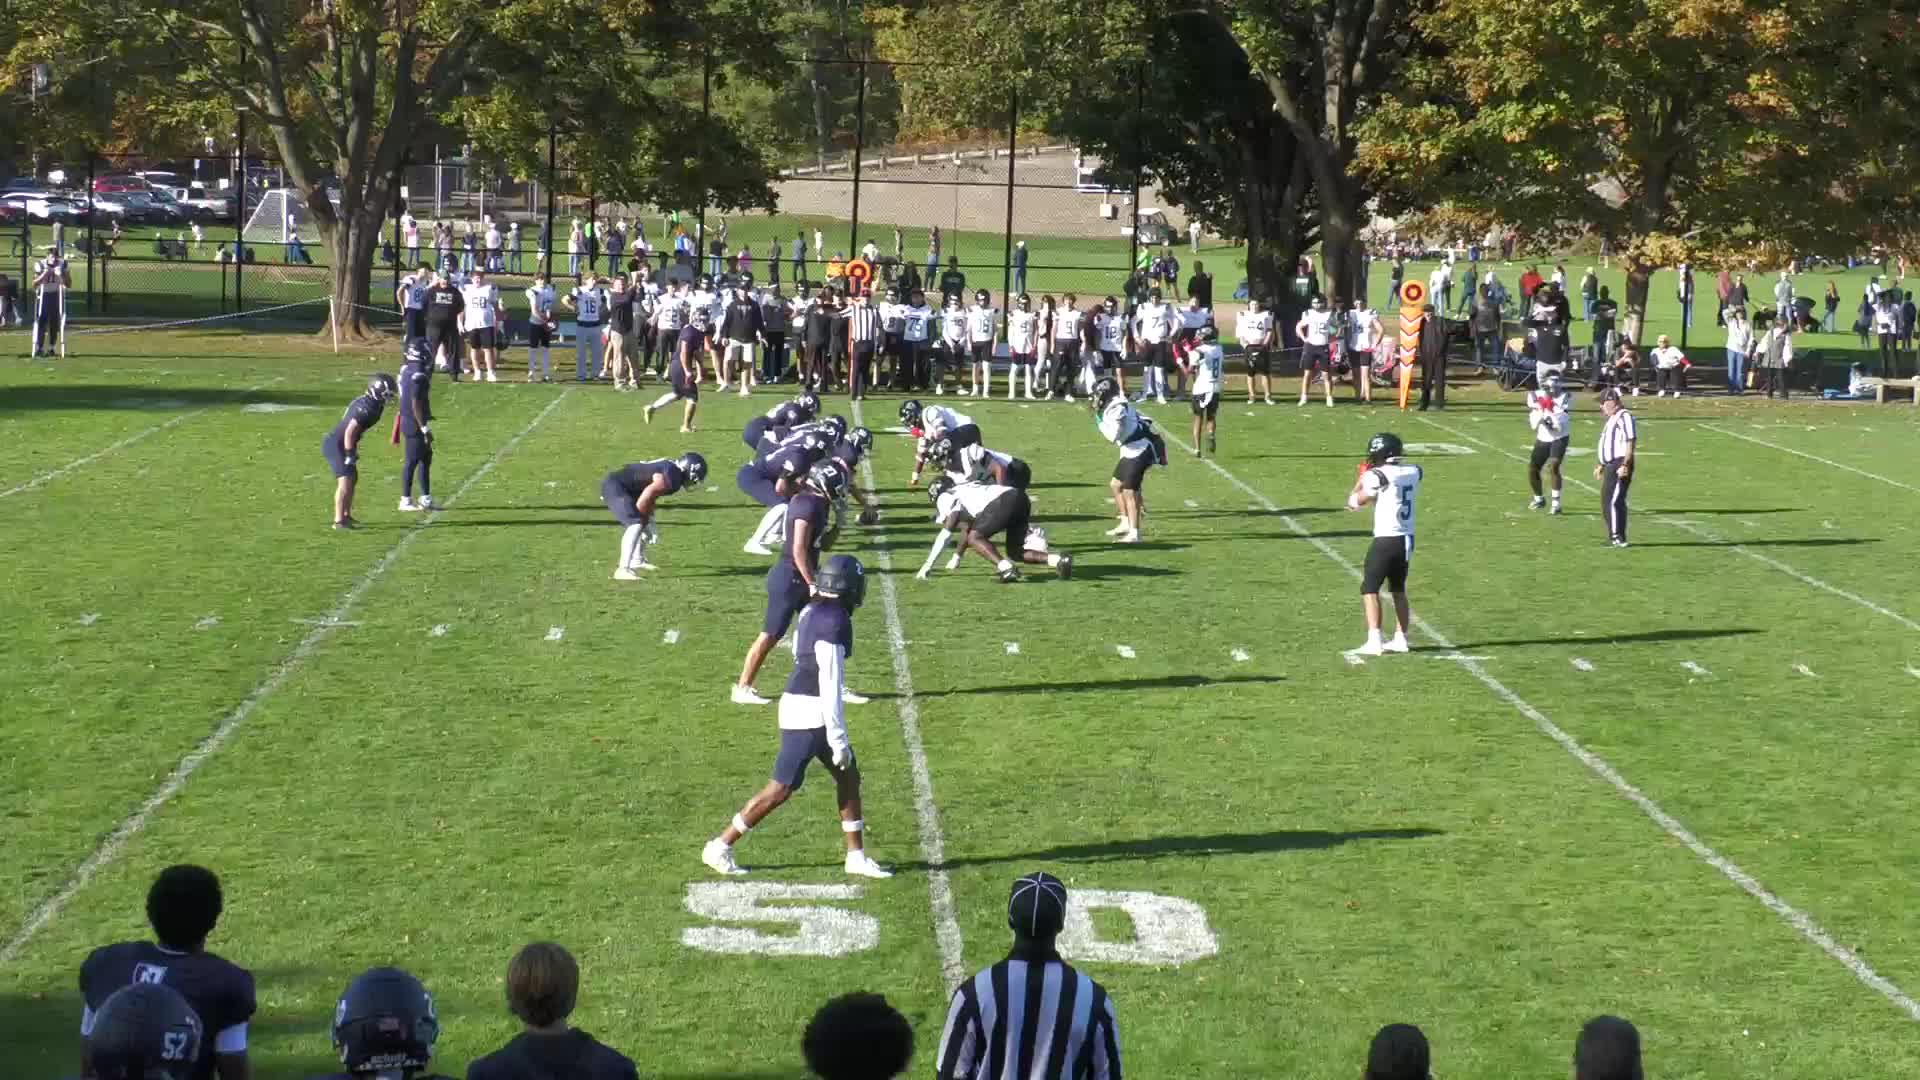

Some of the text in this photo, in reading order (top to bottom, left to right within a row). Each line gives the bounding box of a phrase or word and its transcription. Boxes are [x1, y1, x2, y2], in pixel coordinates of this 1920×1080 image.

[584, 299, 597, 314] 16
[1400, 484, 1414, 521] 5
[161, 1031, 188, 1059] 52
